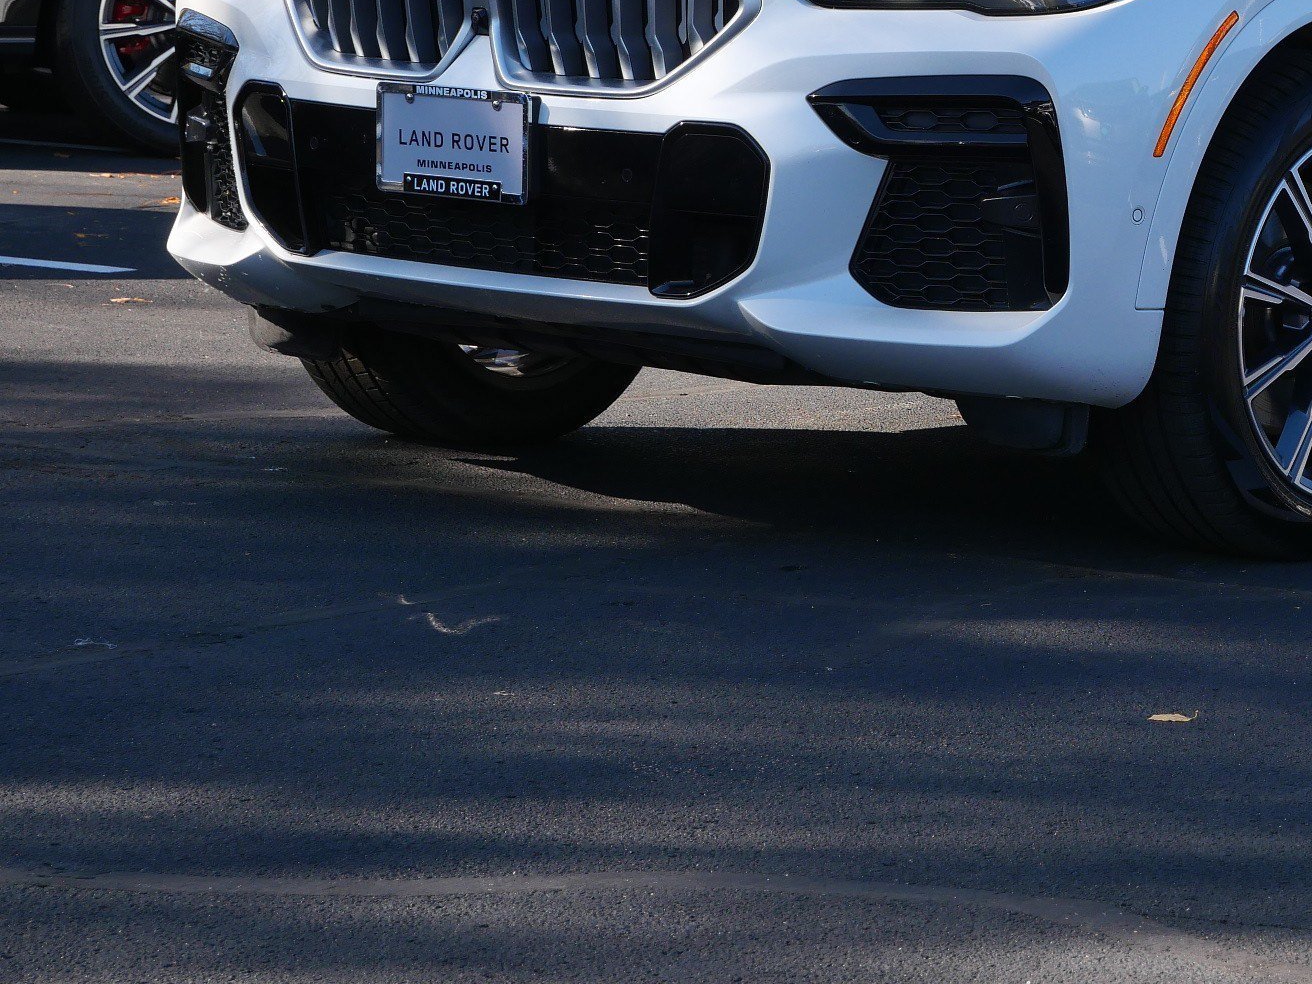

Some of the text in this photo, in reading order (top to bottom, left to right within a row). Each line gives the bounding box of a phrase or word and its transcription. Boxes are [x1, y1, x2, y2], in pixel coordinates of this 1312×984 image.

[416, 85, 488, 100] MINNEAPOLIS
[398, 128, 510, 154] LAND ROVER
[417, 159, 492, 173] MINNEAPOLIS
[414, 177, 490, 197] LAND ROVER
